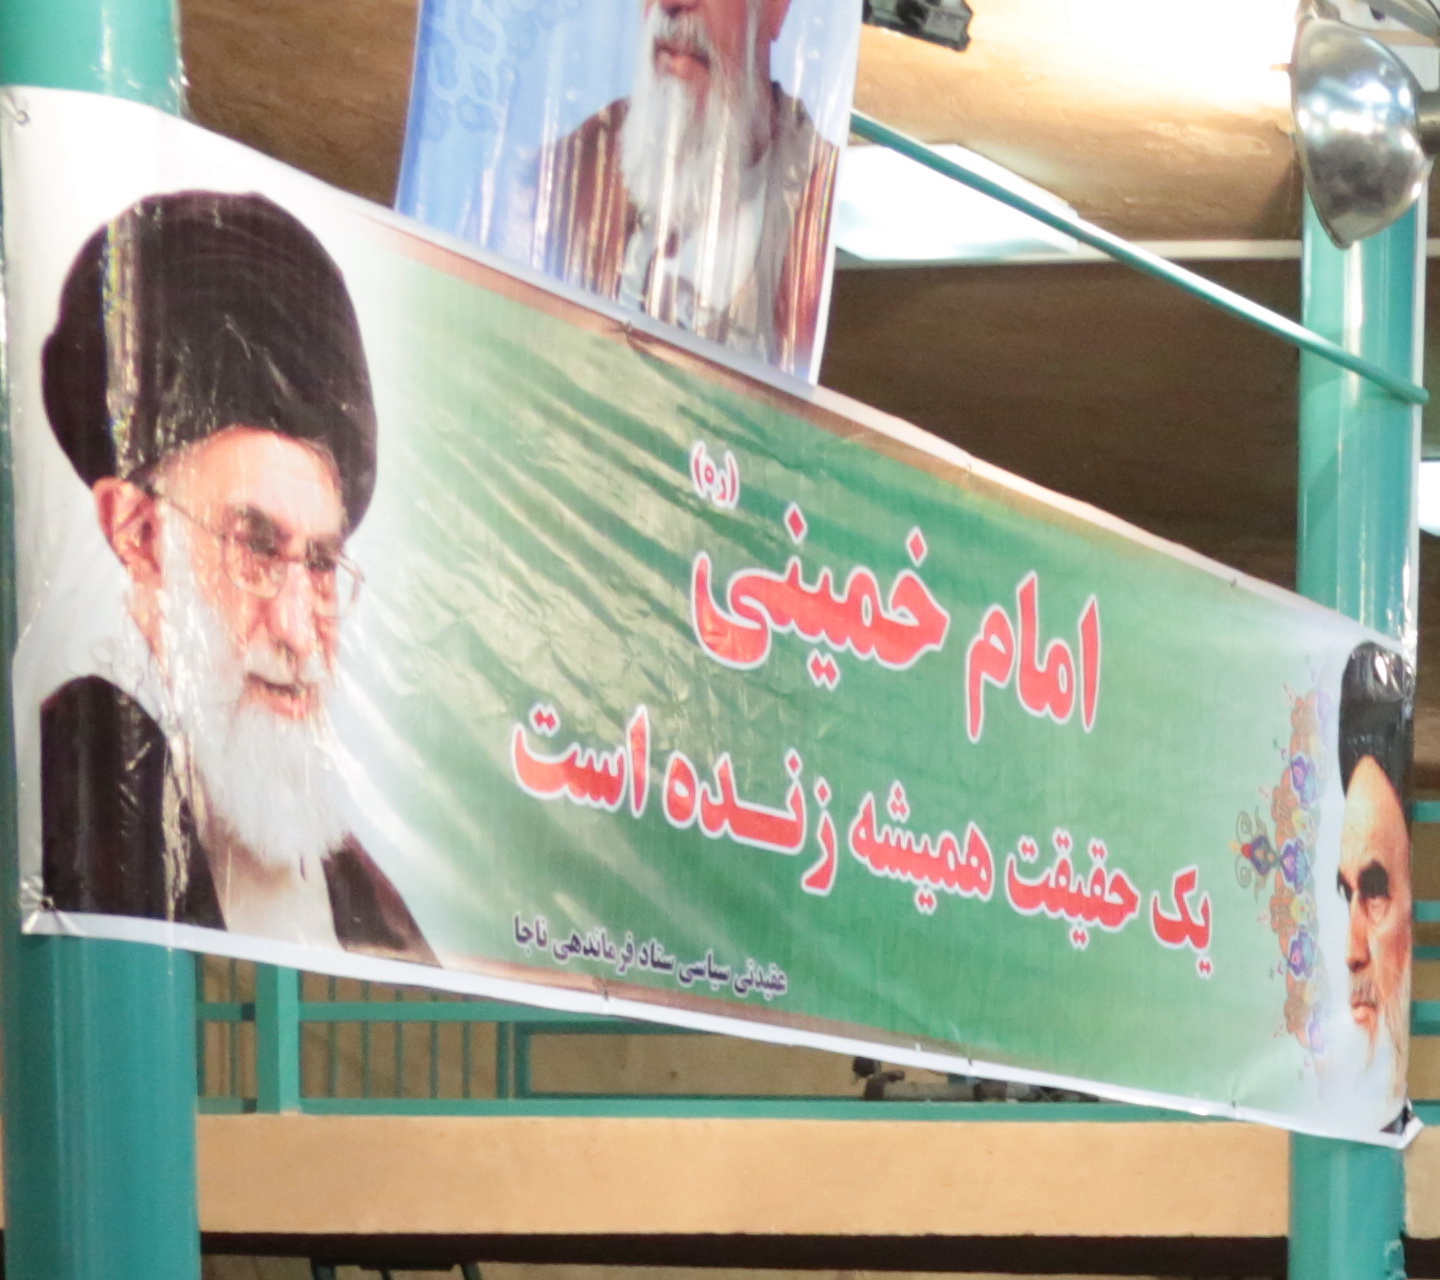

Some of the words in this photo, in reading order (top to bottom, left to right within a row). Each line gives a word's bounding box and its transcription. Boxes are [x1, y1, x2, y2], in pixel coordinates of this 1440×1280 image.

[692, 504, 950, 691] خمینی
[966, 570, 1100, 743] امام
[512, 703, 650, 820] است
[663, 747, 838, 896] زنده
[849, 780, 994, 915] همیشه
[513, 911, 548, 955] ناجا
[1005, 826, 1140, 950] حقیقت
[1151, 864, 1214, 979] یک
[553, 927, 635, 975] فرماندهی
[638, 939, 676, 973] ستاد
[679, 949, 730, 990] سیاسی
